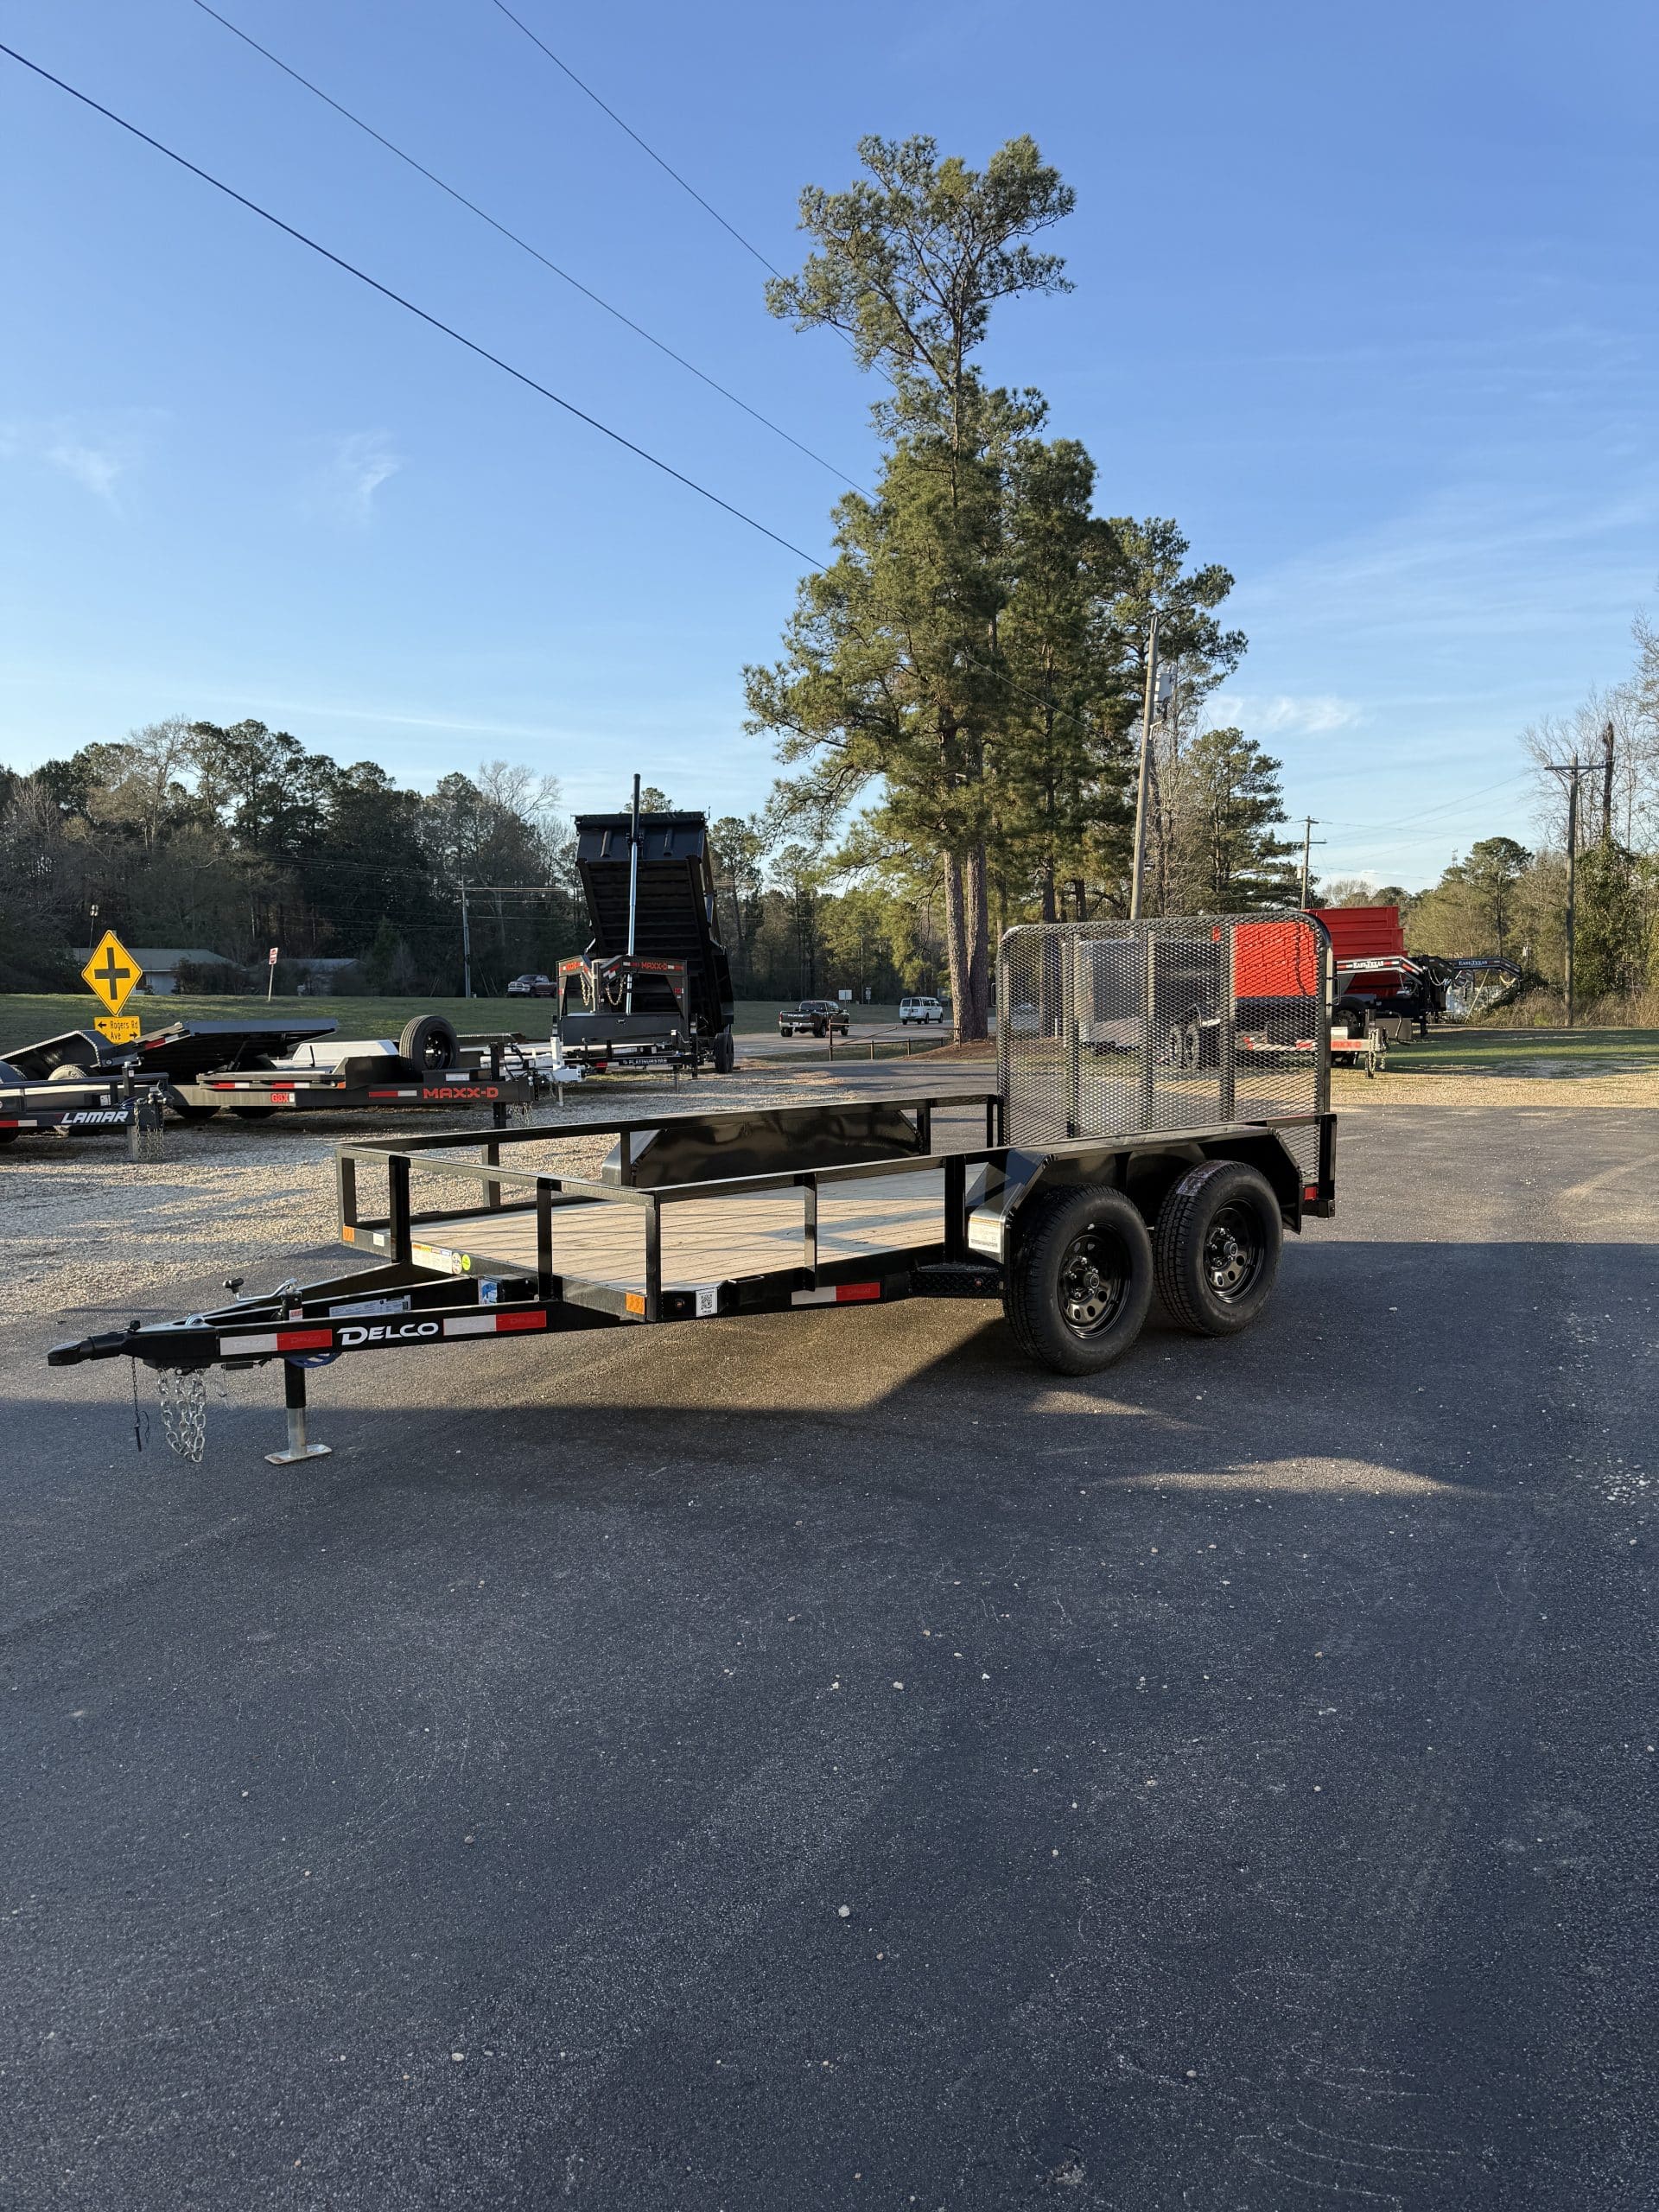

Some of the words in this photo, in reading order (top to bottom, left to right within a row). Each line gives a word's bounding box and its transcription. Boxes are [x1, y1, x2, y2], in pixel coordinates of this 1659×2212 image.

[111, 1020, 129, 1031] Rogers
[131, 1020, 138, 1029] Rd
[111, 1032, 121, 1040] Ave
[423, 1087, 499, 1098] MAXX-D
[60, 1111, 129, 1123] LAMAR
[336, 1322, 439, 1345] DELCO
